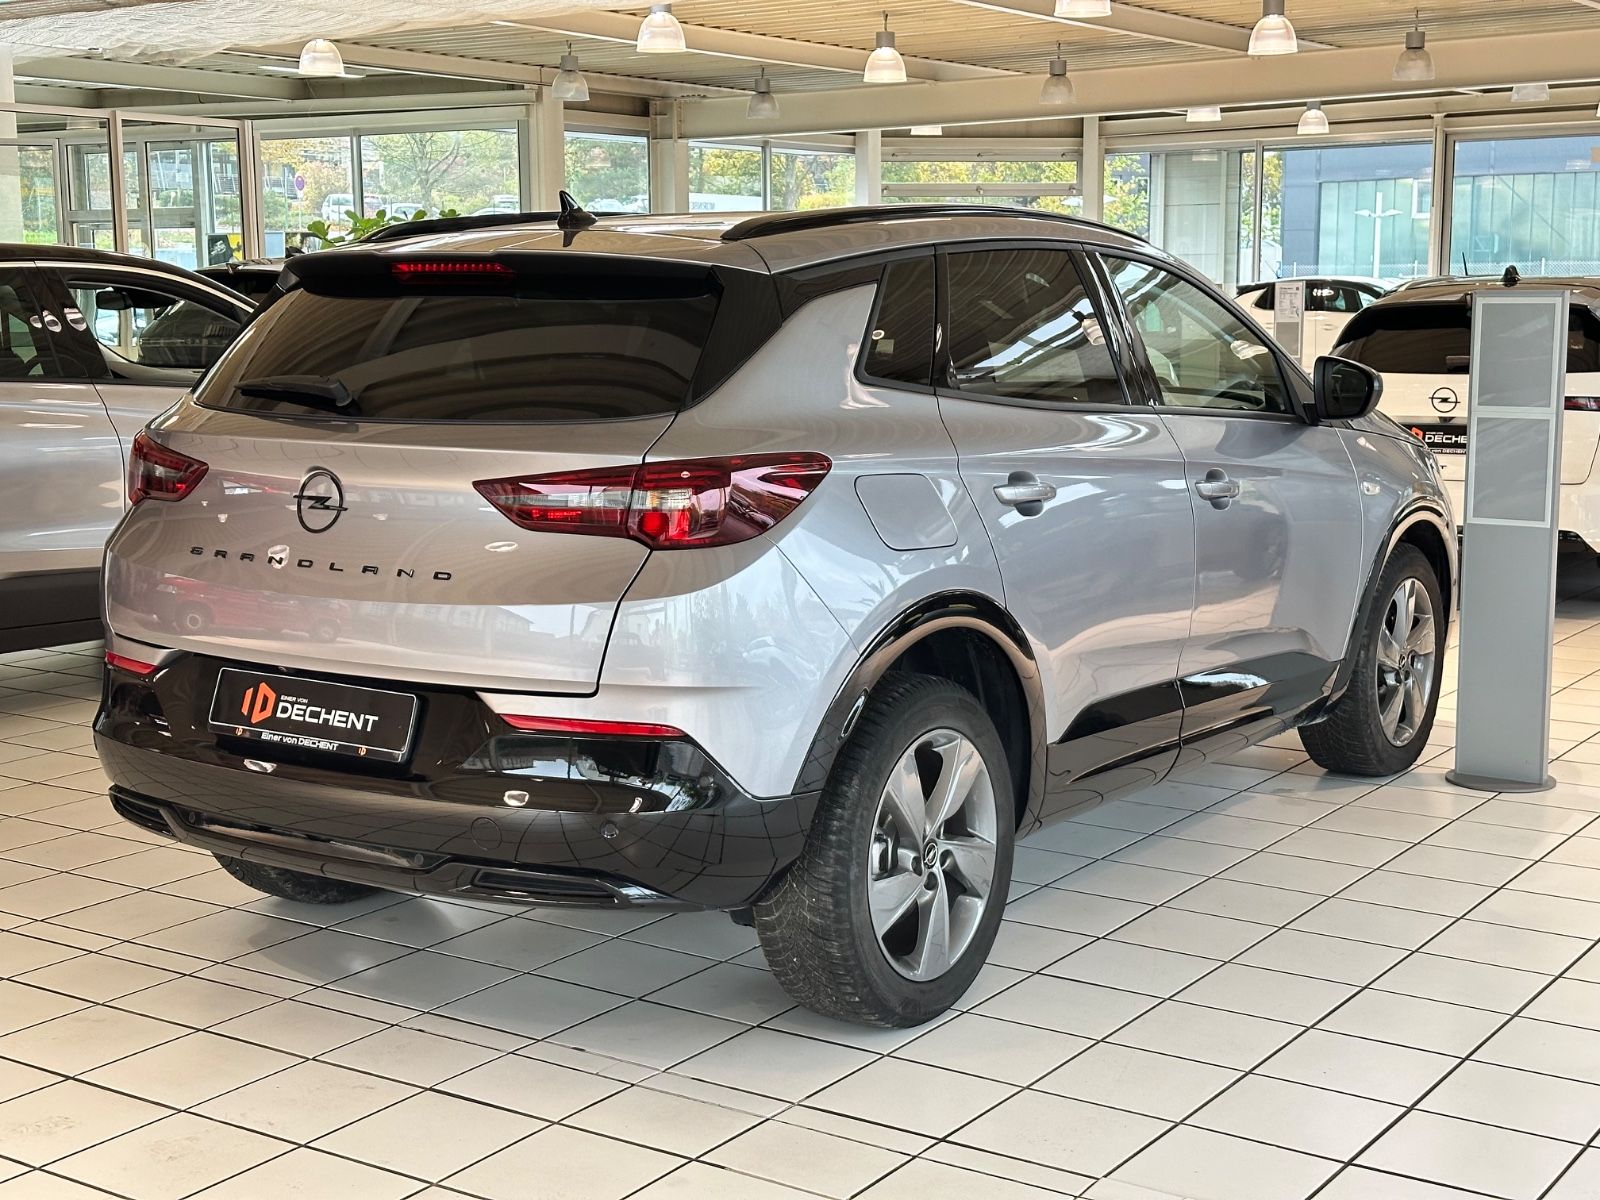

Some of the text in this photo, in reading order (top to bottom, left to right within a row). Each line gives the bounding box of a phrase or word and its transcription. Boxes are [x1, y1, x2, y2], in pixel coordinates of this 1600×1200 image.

[1425, 434, 1467, 443] DECHE
[190, 546, 452, 581] GRANDLAND
[276, 702, 379, 732] DECHENT
[261, 732, 339, 751] Einer von DECHENT
